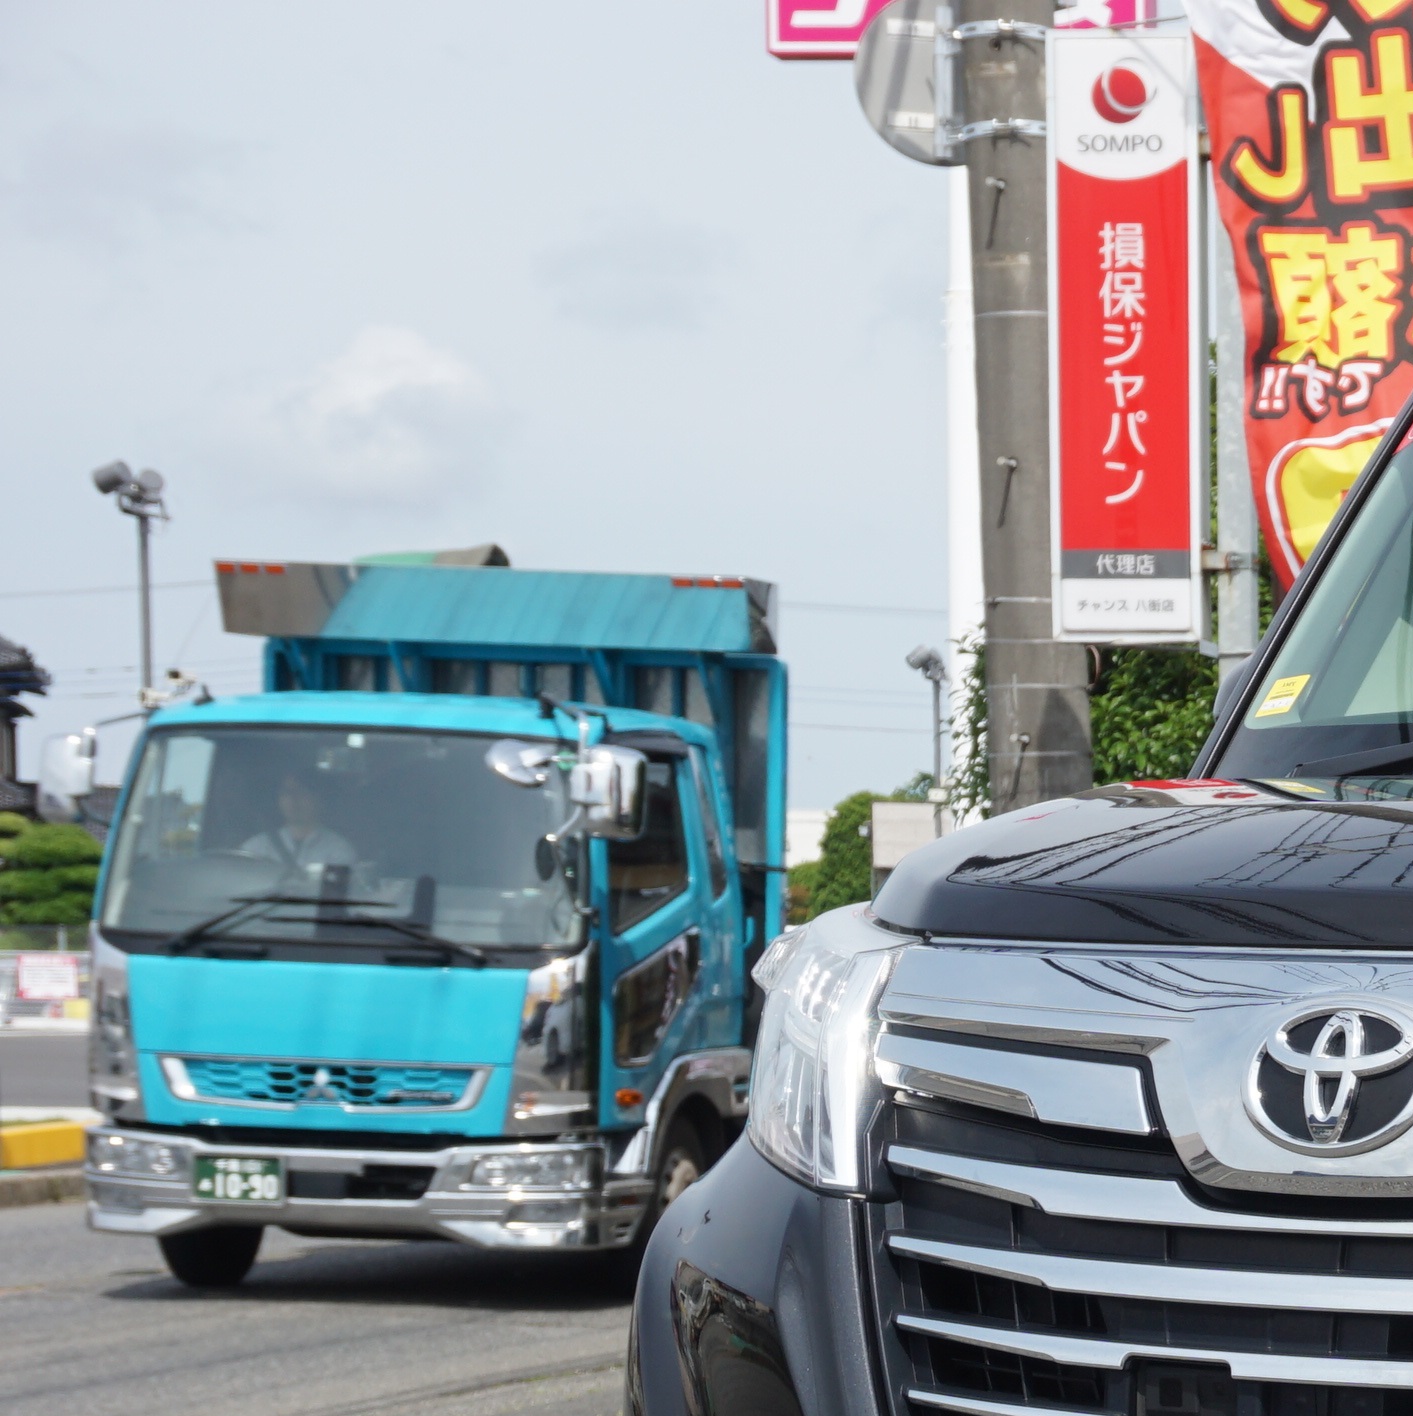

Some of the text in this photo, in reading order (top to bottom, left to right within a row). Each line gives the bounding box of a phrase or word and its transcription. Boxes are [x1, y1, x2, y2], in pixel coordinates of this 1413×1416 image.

[1077, 134, 1163, 152] SOMPO
[1098, 222, 1146, 504] 損保ジャパン
[1096, 554, 1155, 575] 代理店
[1077, 600, 1128, 613] チャンス
